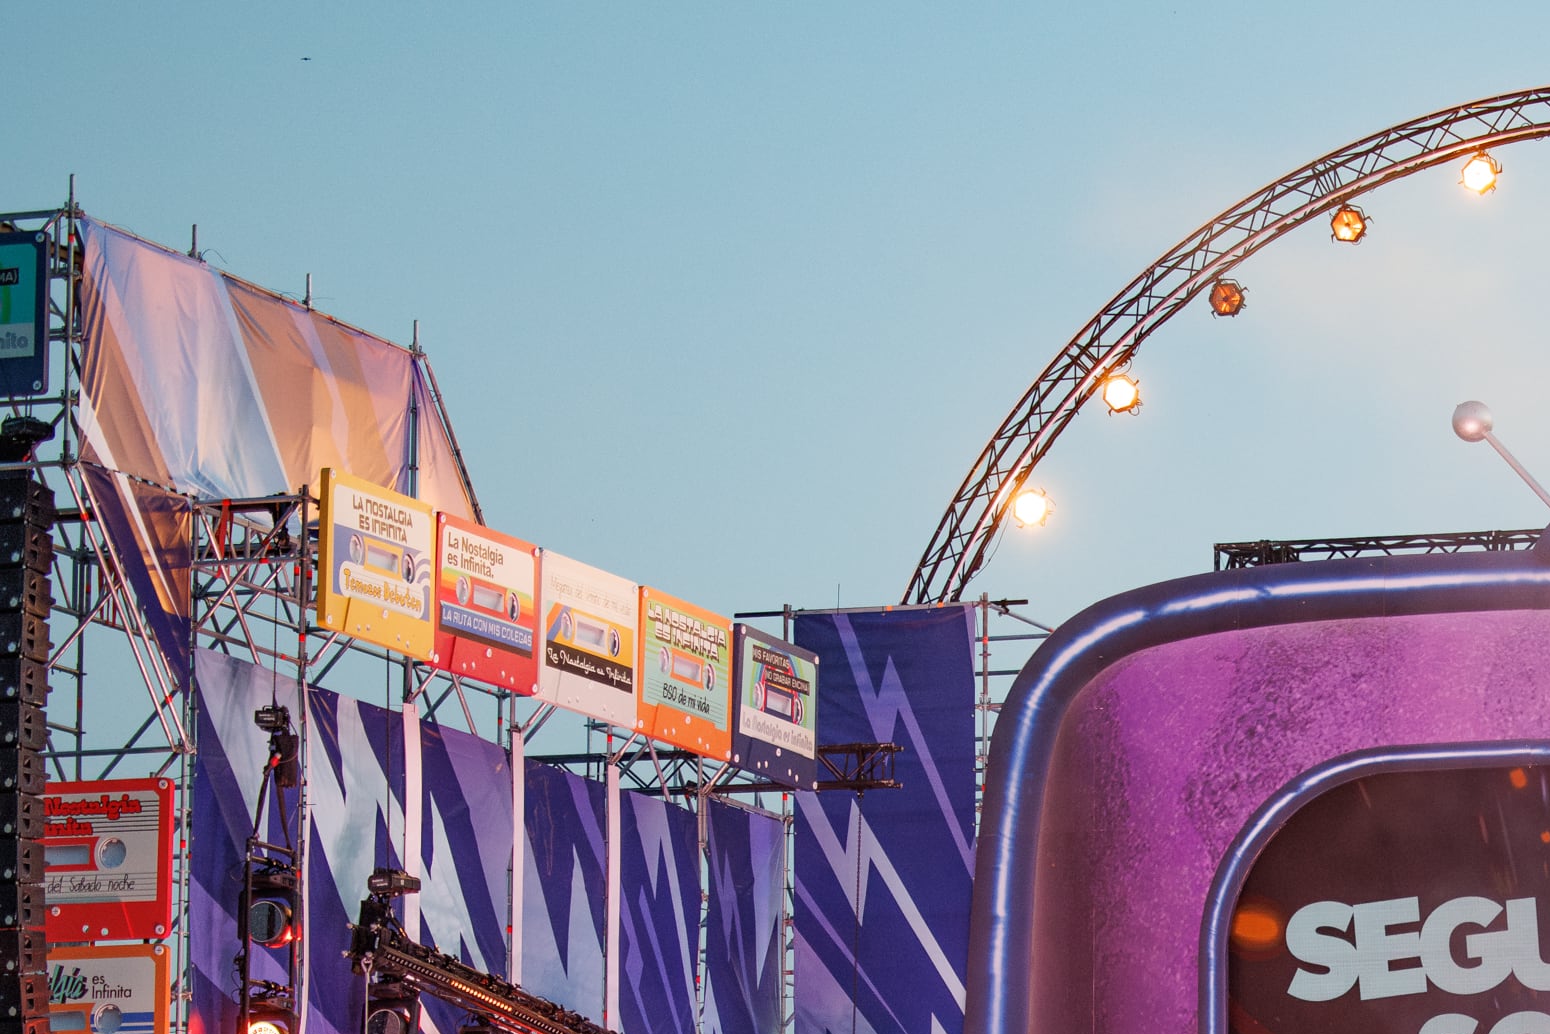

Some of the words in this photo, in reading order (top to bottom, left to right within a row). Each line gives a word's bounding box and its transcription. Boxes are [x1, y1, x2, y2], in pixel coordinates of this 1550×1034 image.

[353, 494, 363, 511] LA
[366, 499, 413, 528] NOSTALGIA
[359, 514, 370, 531] ES
[372, 520, 407, 544] INFINITA
[448, 532, 459, 549] La
[461, 534, 504, 566] Nostalgia
[448, 552, 458, 566] es
[442, 608, 452, 621] LA
[453, 611, 472, 628] RUTA
[472, 617, 487, 633] CON
[488, 621, 500, 637] MIS
[501, 626, 532, 647] COLEGAS
[648, 602, 662, 621] LA
[664, 607, 727, 651] NOSTALGIA
[655, 621, 671, 644] ES
[671, 626, 720, 663] INFINITA
[678, 688, 687, 705] de
[697, 695, 710, 714] vida
[47, 877, 64, 894] del
[107, 873, 135, 892] noche
[91, 984, 132, 999] Infinita
[92, 974, 105, 985] es
